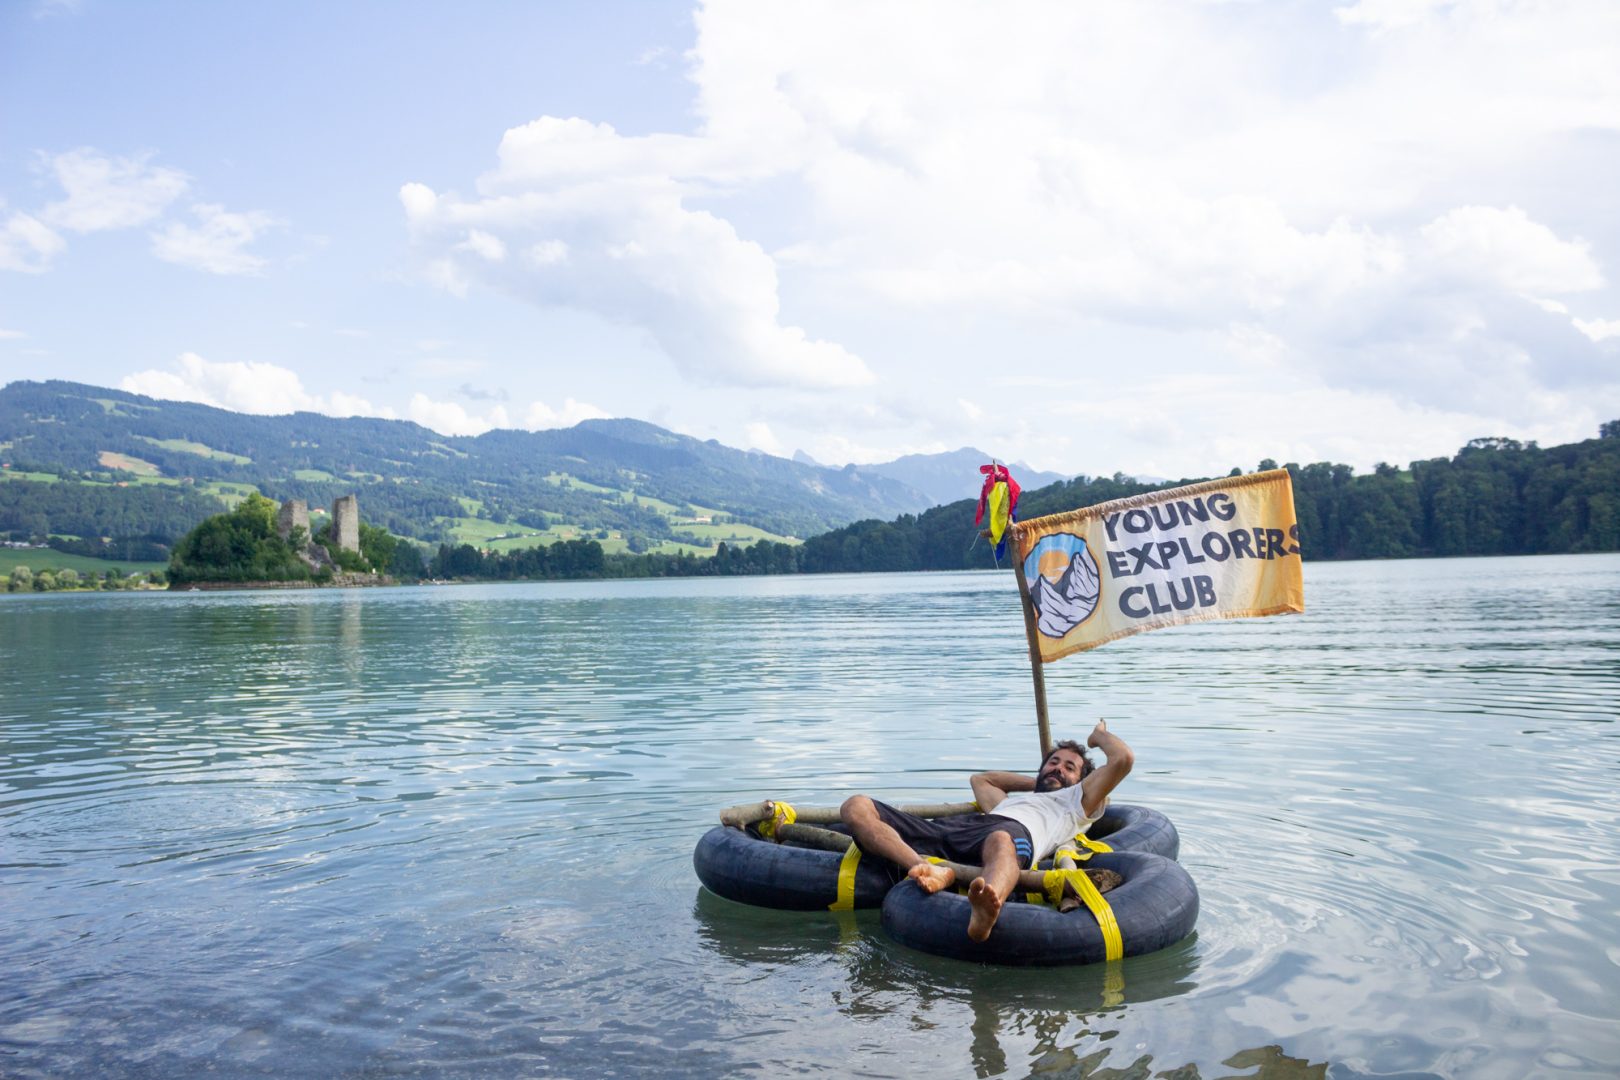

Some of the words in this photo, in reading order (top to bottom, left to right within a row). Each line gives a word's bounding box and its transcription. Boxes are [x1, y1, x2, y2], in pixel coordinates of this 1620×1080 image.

[1102, 493, 1236, 541] YOUNG
[1106, 524, 1300, 578] EXPLORERS
[1118, 575, 1217, 619] CLUB
